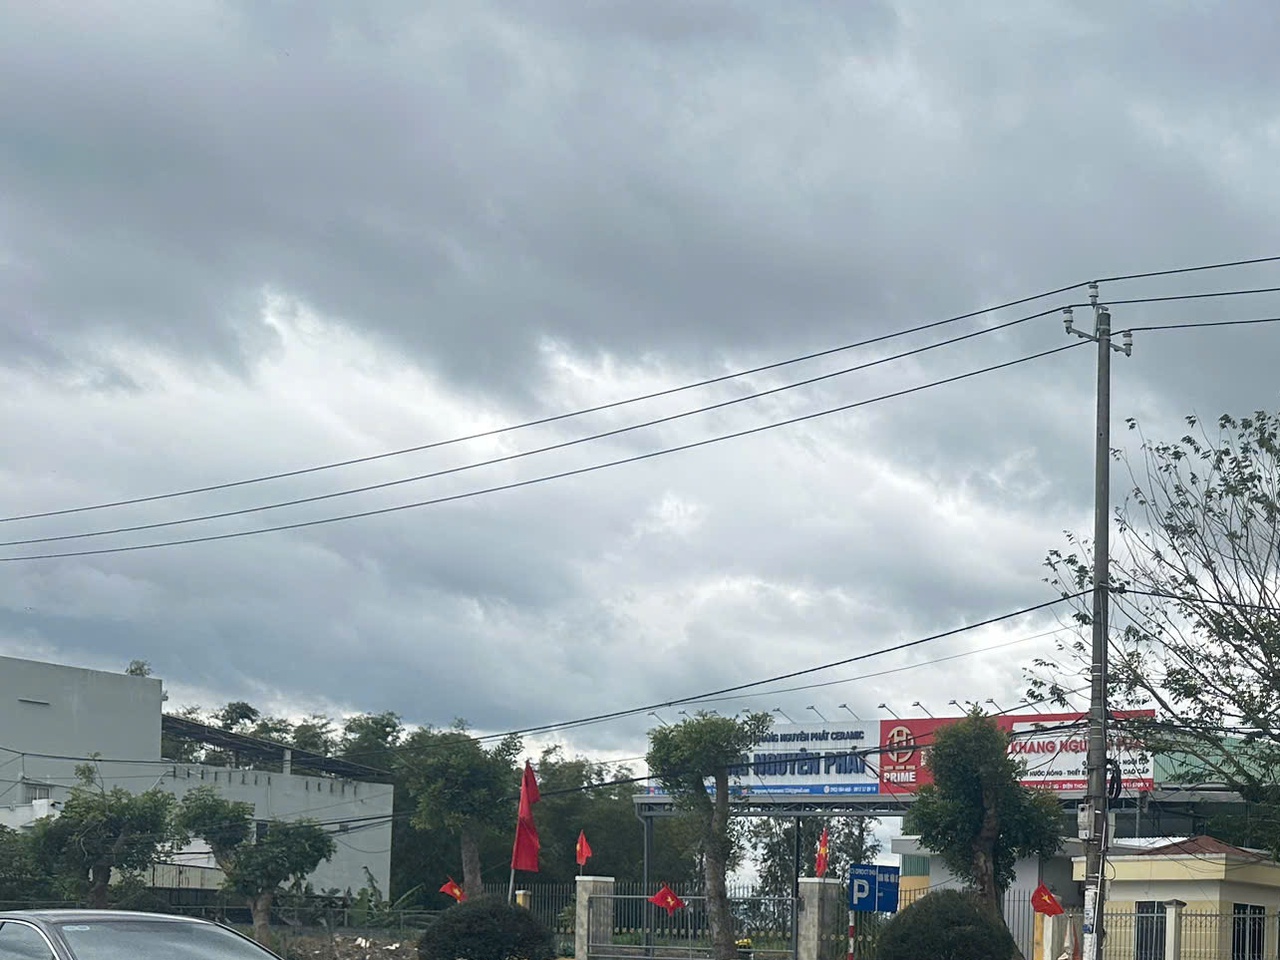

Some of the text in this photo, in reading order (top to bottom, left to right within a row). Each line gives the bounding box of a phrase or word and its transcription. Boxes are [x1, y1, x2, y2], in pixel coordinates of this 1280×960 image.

[780, 730, 810, 743] NGUYÊN
[811, 729, 830, 742] PHÁT
[831, 731, 865, 741] CERAMIC
[1010, 740, 1056, 754] KHANG
[754, 747, 821, 776] NGUYÊN
[824, 746, 866, 775] PHÁT
[883, 771, 917, 783] PRIME
[853, 878, 870, 905] P
